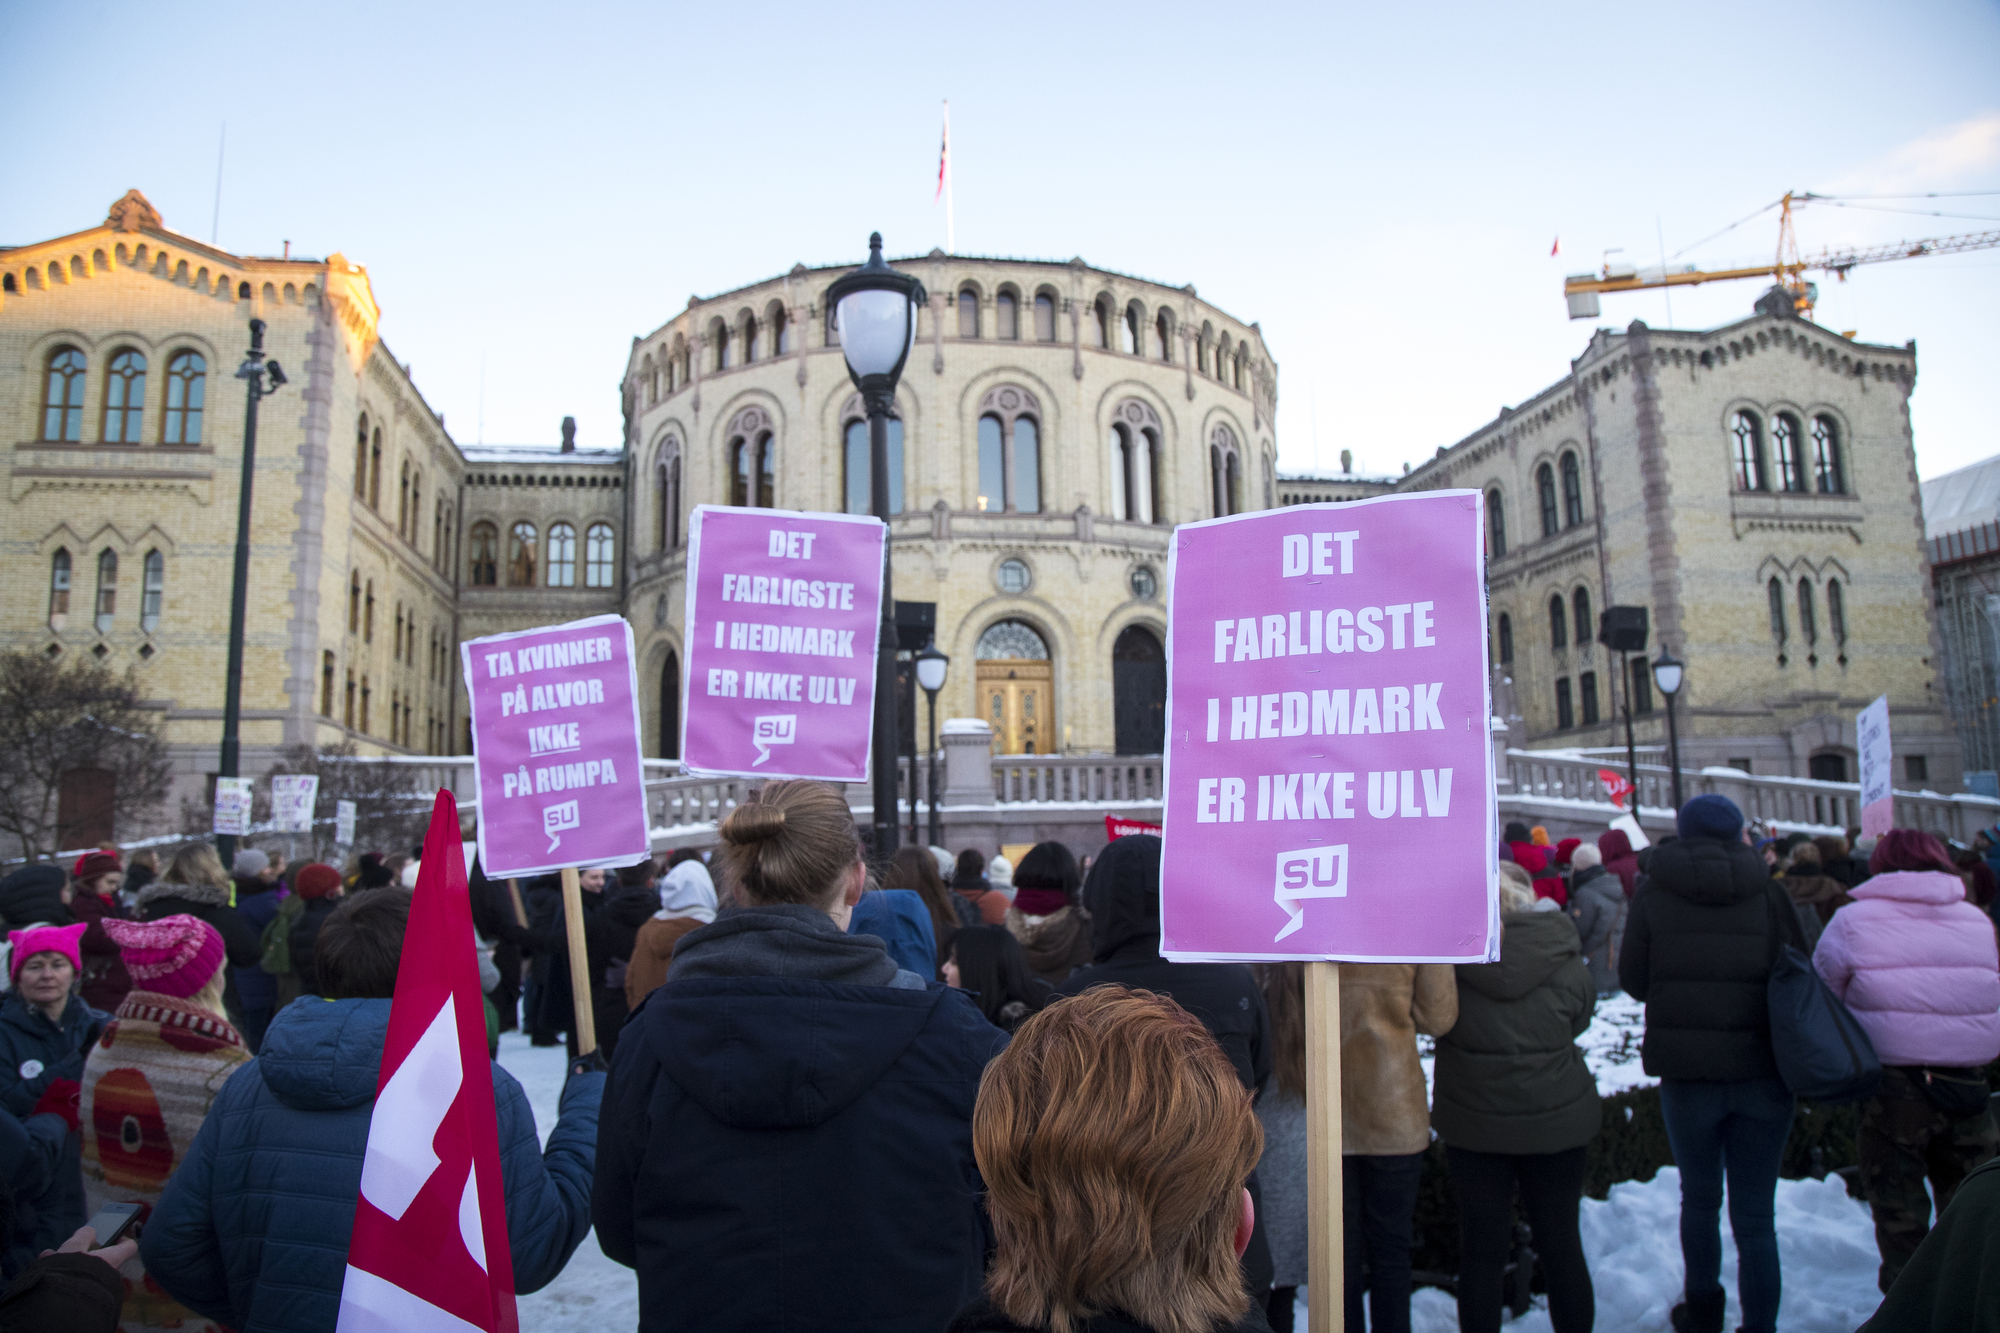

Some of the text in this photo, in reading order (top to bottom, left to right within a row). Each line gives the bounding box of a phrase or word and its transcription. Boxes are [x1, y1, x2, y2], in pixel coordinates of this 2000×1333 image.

[769, 530, 816, 559] DET
[1283, 531, 1359, 577] DET
[723, 574, 854, 610] FARLIGSTE
[715, 621, 855, 658] I HEDMARK
[1215, 601, 1435, 663] FARLIGSTE
[485, 637, 611, 677] TA KVINNER
[502, 679, 604, 716] PÅ ALVOR
[708, 669, 856, 705] ER IKKE ULV
[759, 720, 791, 738] SU
[1207, 683, 1445, 742] I HEDMARK
[529, 723, 580, 753] IKKE
[503, 759, 617, 798] PÅ RUMPA
[1197, 768, 1453, 823] ER IKKE ULV
[547, 806, 574, 827] SU
[1282, 854, 1340, 890] SU
